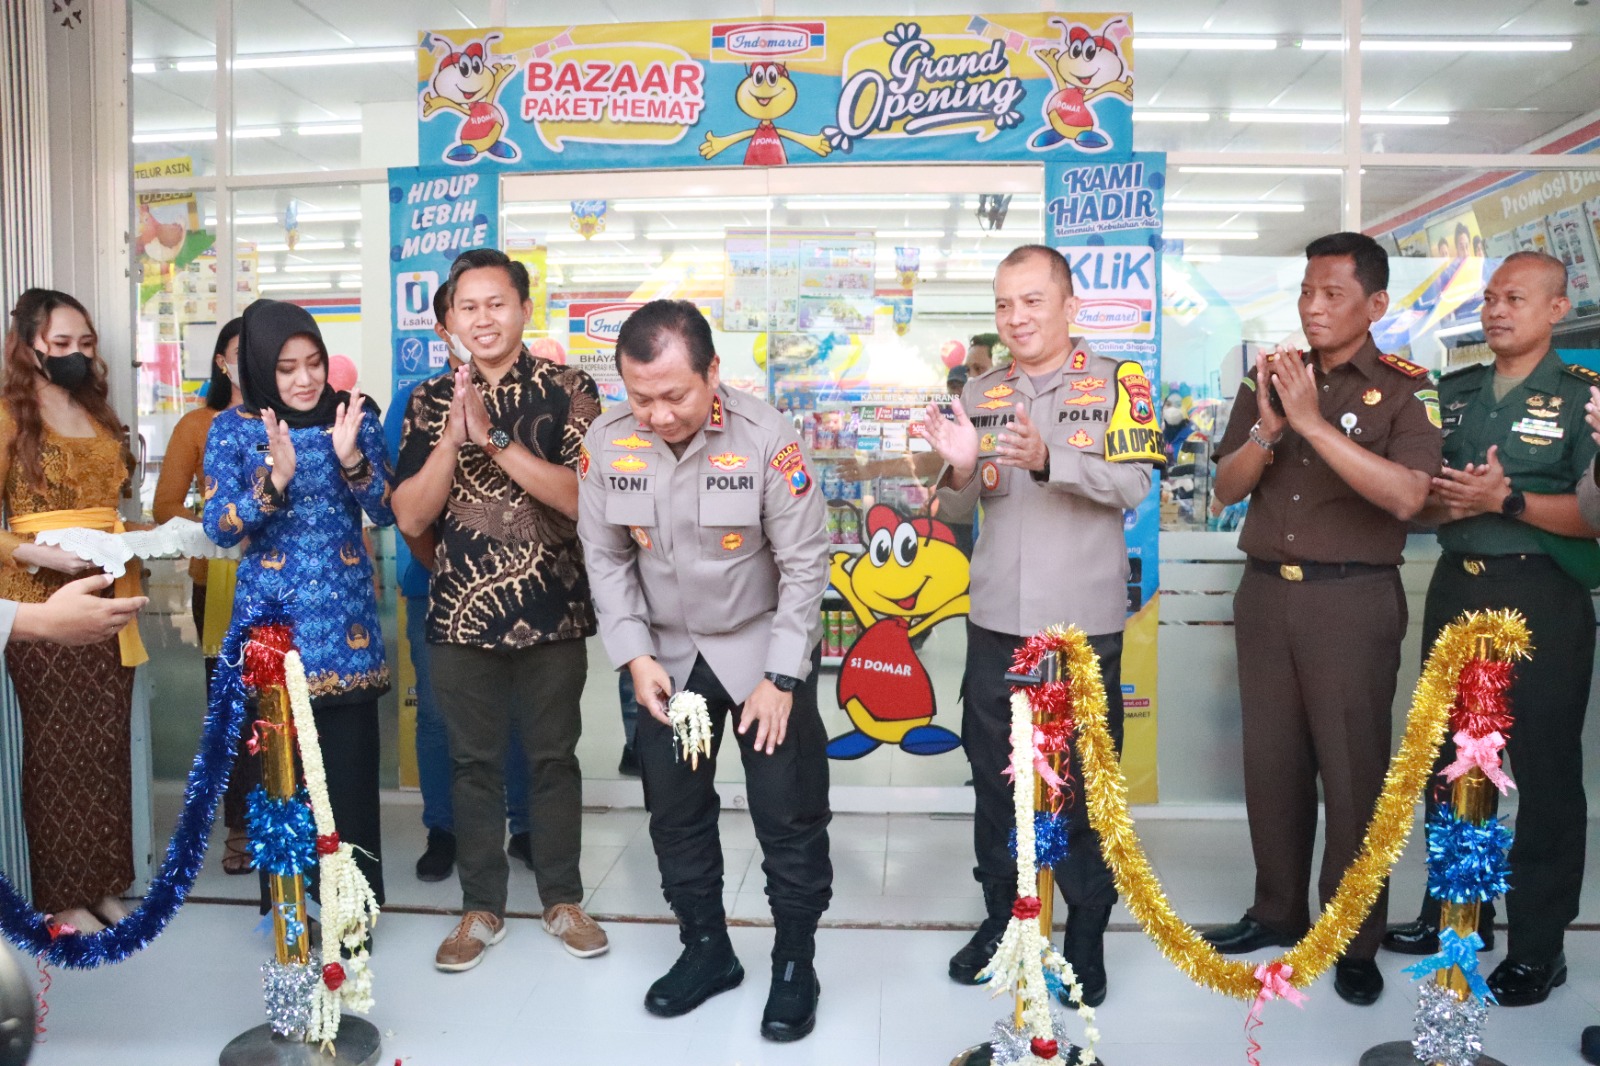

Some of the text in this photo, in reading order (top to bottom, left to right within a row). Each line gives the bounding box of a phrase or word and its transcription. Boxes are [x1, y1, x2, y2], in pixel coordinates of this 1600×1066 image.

[732, 35, 804, 49] Indomaret
[889, 39, 1004, 95] Grand
[527, 62, 700, 97] BAZAAR
[524, 97, 700, 121] PAKET HEMAT
[839, 70, 1023, 137] Opening
[135, 163, 190, 179] TELUR ASIN
[1063, 163, 1143, 194] KAMI
[407, 173, 479, 205] HIDUP
[1501, 171, 1567, 219] Promosi
[411, 199, 478, 230] LEBIH
[1049, 190, 1157, 226] HADIR
[401, 224, 488, 260] MOBILE
[402, 317, 434, 327] i.saku
[1077, 309, 1137, 322] Indomaret
[1098, 342, 1124, 350] Online
[1058, 409, 1109, 423] POLRI
[772, 443, 798, 467] POLDA
[1106, 428, 1129, 458] KA
[609, 476, 648, 491] TONI
[706, 475, 754, 490] POLRI
[863, 659, 912, 676] DOMAR
